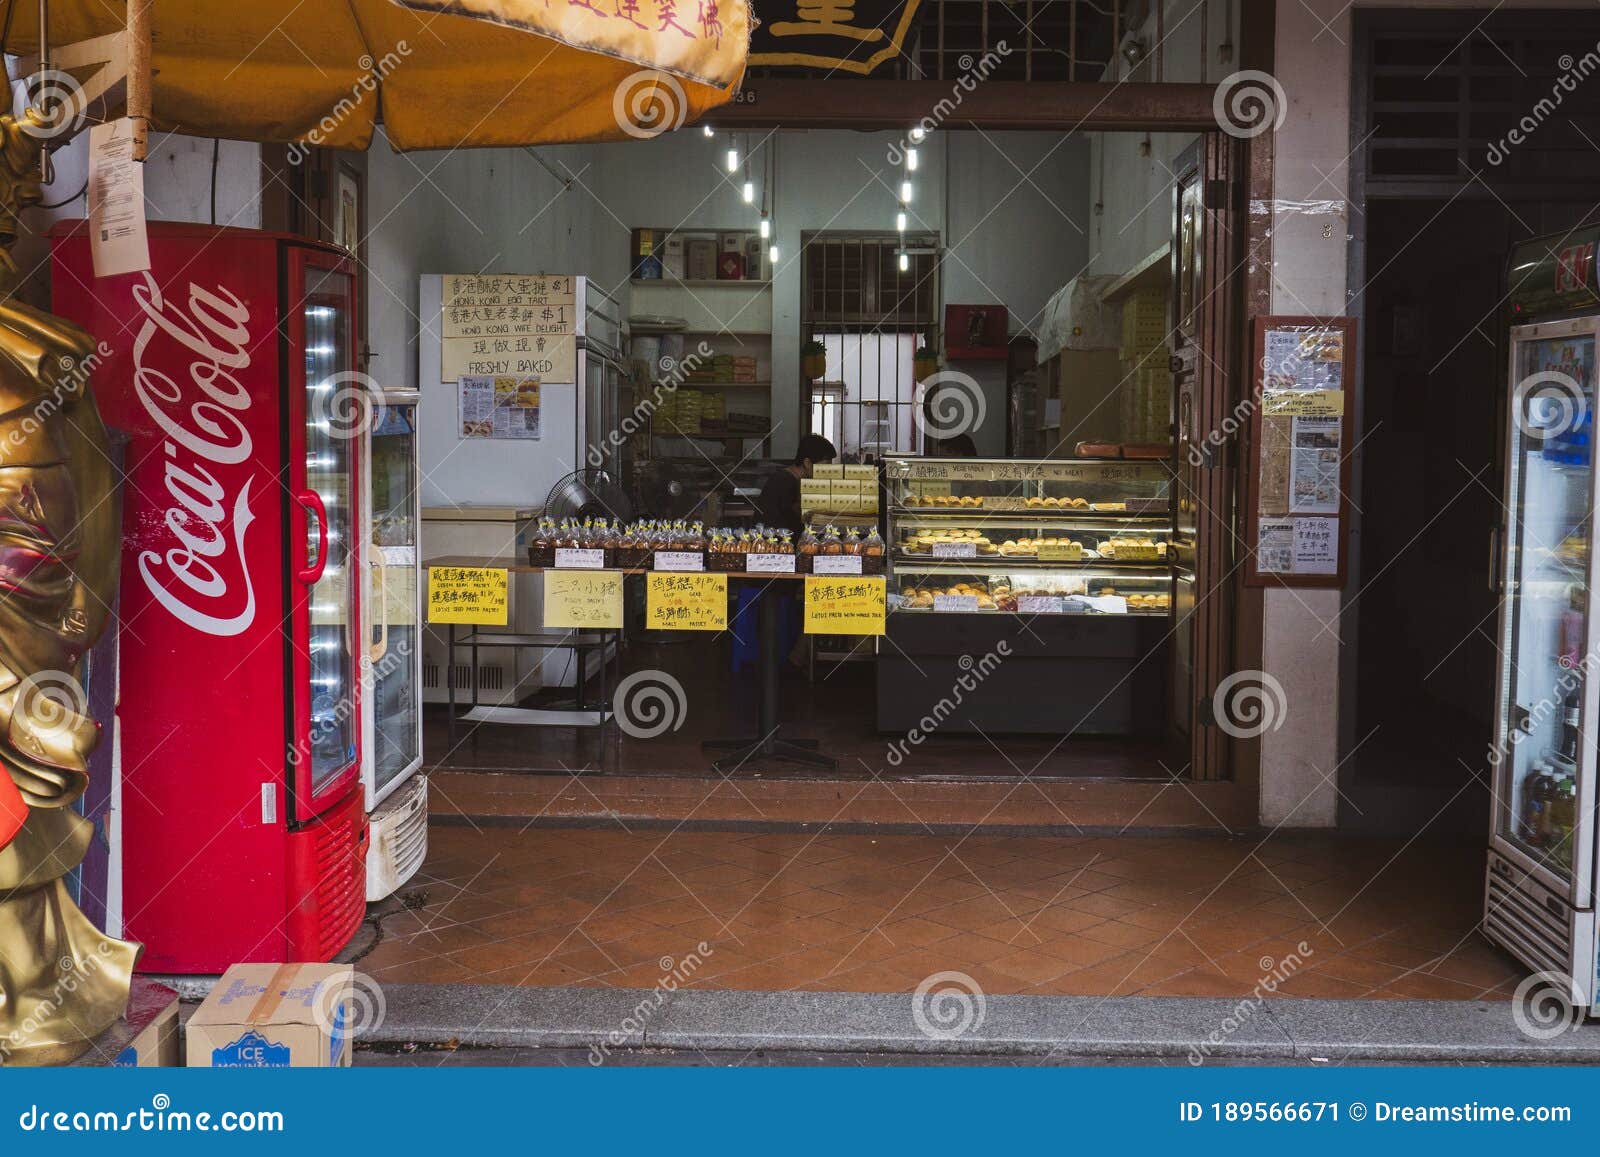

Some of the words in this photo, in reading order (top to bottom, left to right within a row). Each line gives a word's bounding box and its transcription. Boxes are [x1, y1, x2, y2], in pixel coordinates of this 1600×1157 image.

[552, 278, 572, 295] $1
[454, 297, 475, 306] HONG
[480, 296, 500, 305] KONG
[507, 296, 523, 304] EGG
[541, 307, 567, 323] $1
[462, 327, 481, 335] HONG
[487, 324, 508, 333] KONG
[515, 323, 531, 332] WIFE
[536, 323, 568, 333] DELIGHT
[469, 360, 509, 374] FRESHLY
[517, 360, 552, 373] BAKED
[238, 1048, 265, 1061] ICE
